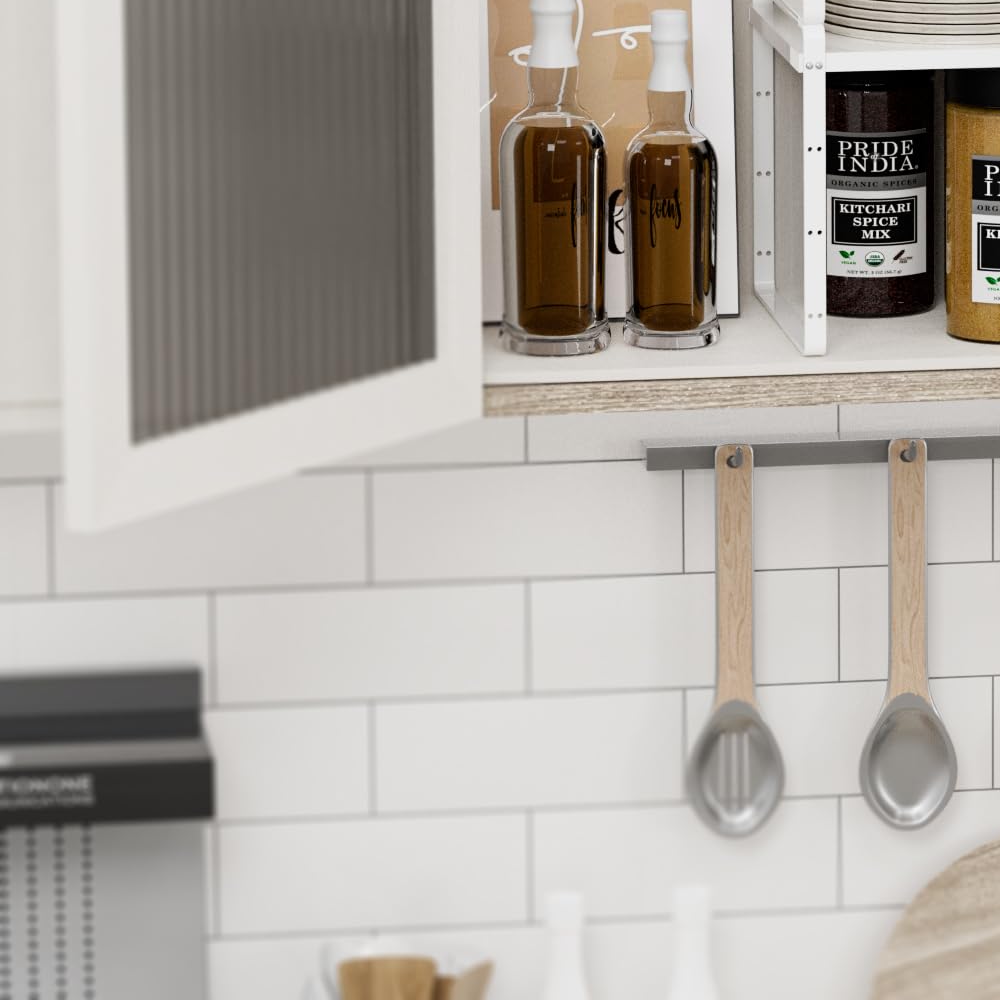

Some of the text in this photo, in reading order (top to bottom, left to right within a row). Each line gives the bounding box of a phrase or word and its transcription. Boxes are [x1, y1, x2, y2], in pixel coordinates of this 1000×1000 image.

[837, 139, 914, 157] PRIDE
[831, 178, 918, 188] ORGANIC SPICES
[839, 202, 912, 214] KITCHARI
[852, 216, 899, 227] SPICE
[861, 229, 891, 240] MIX
